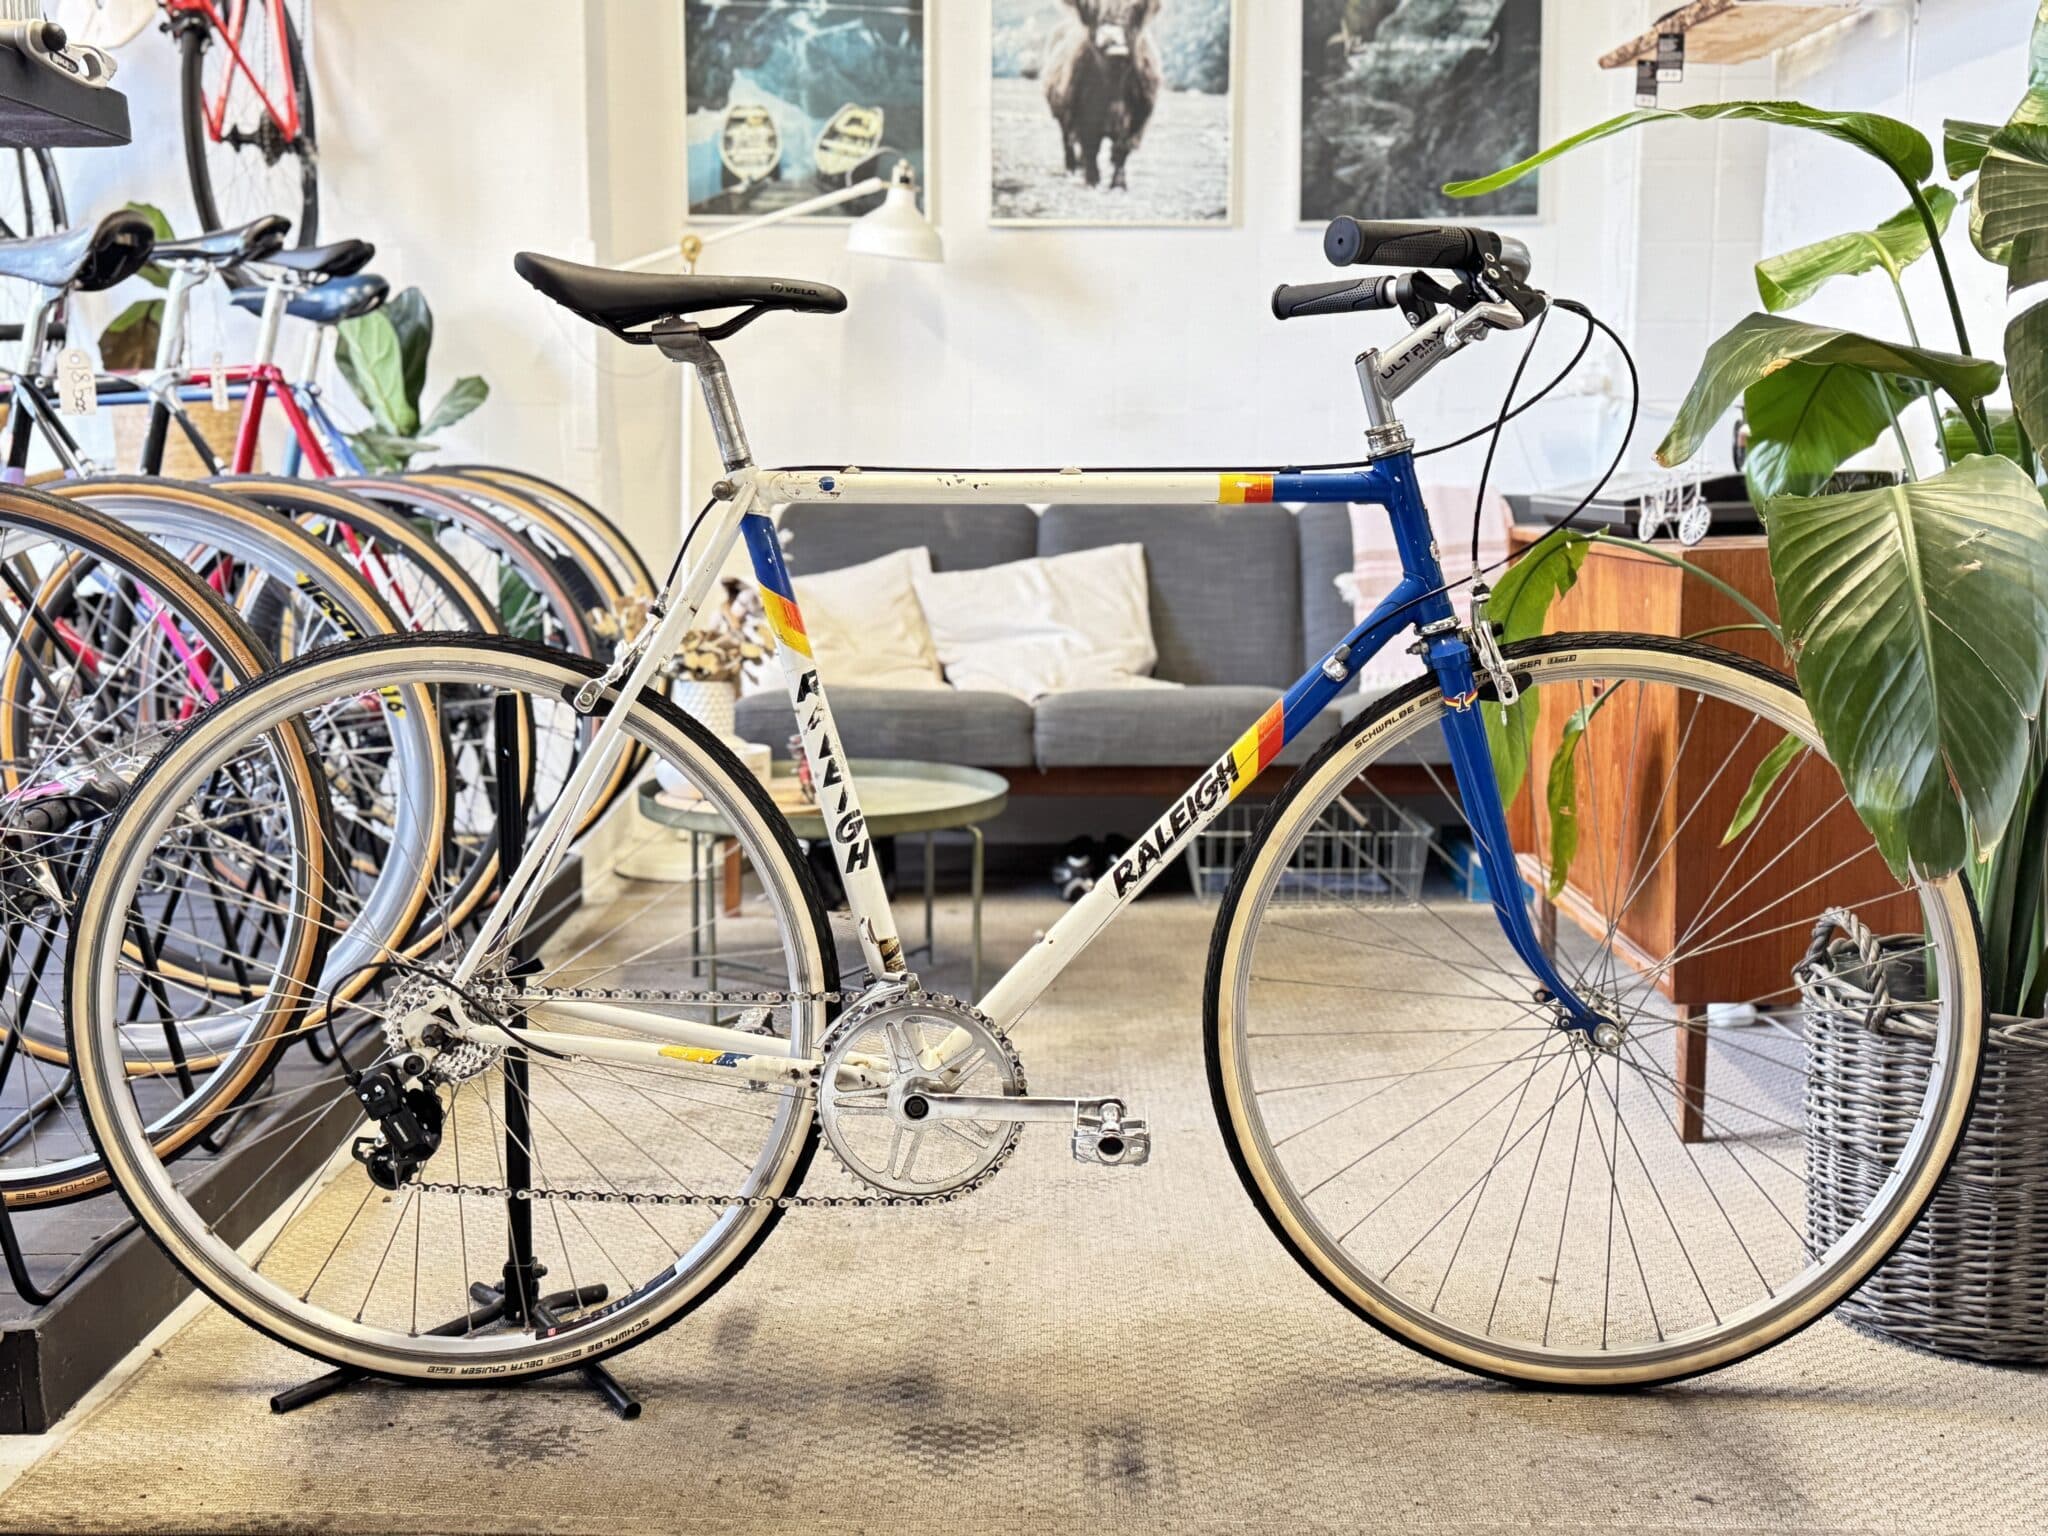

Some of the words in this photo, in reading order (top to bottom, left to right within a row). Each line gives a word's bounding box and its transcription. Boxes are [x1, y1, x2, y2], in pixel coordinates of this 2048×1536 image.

[785, 287, 817, 296] VELO
[1381, 326, 1444, 379] ULTRAX
[1354, 704, 1416, 750] SCHWALBE
[1113, 752, 1239, 899] RALEIGH
[588, 1318, 650, 1352] SCHWALBE
[461, 1365, 506, 1375] CRUISER
[511, 1359, 543, 1372] DELTA
